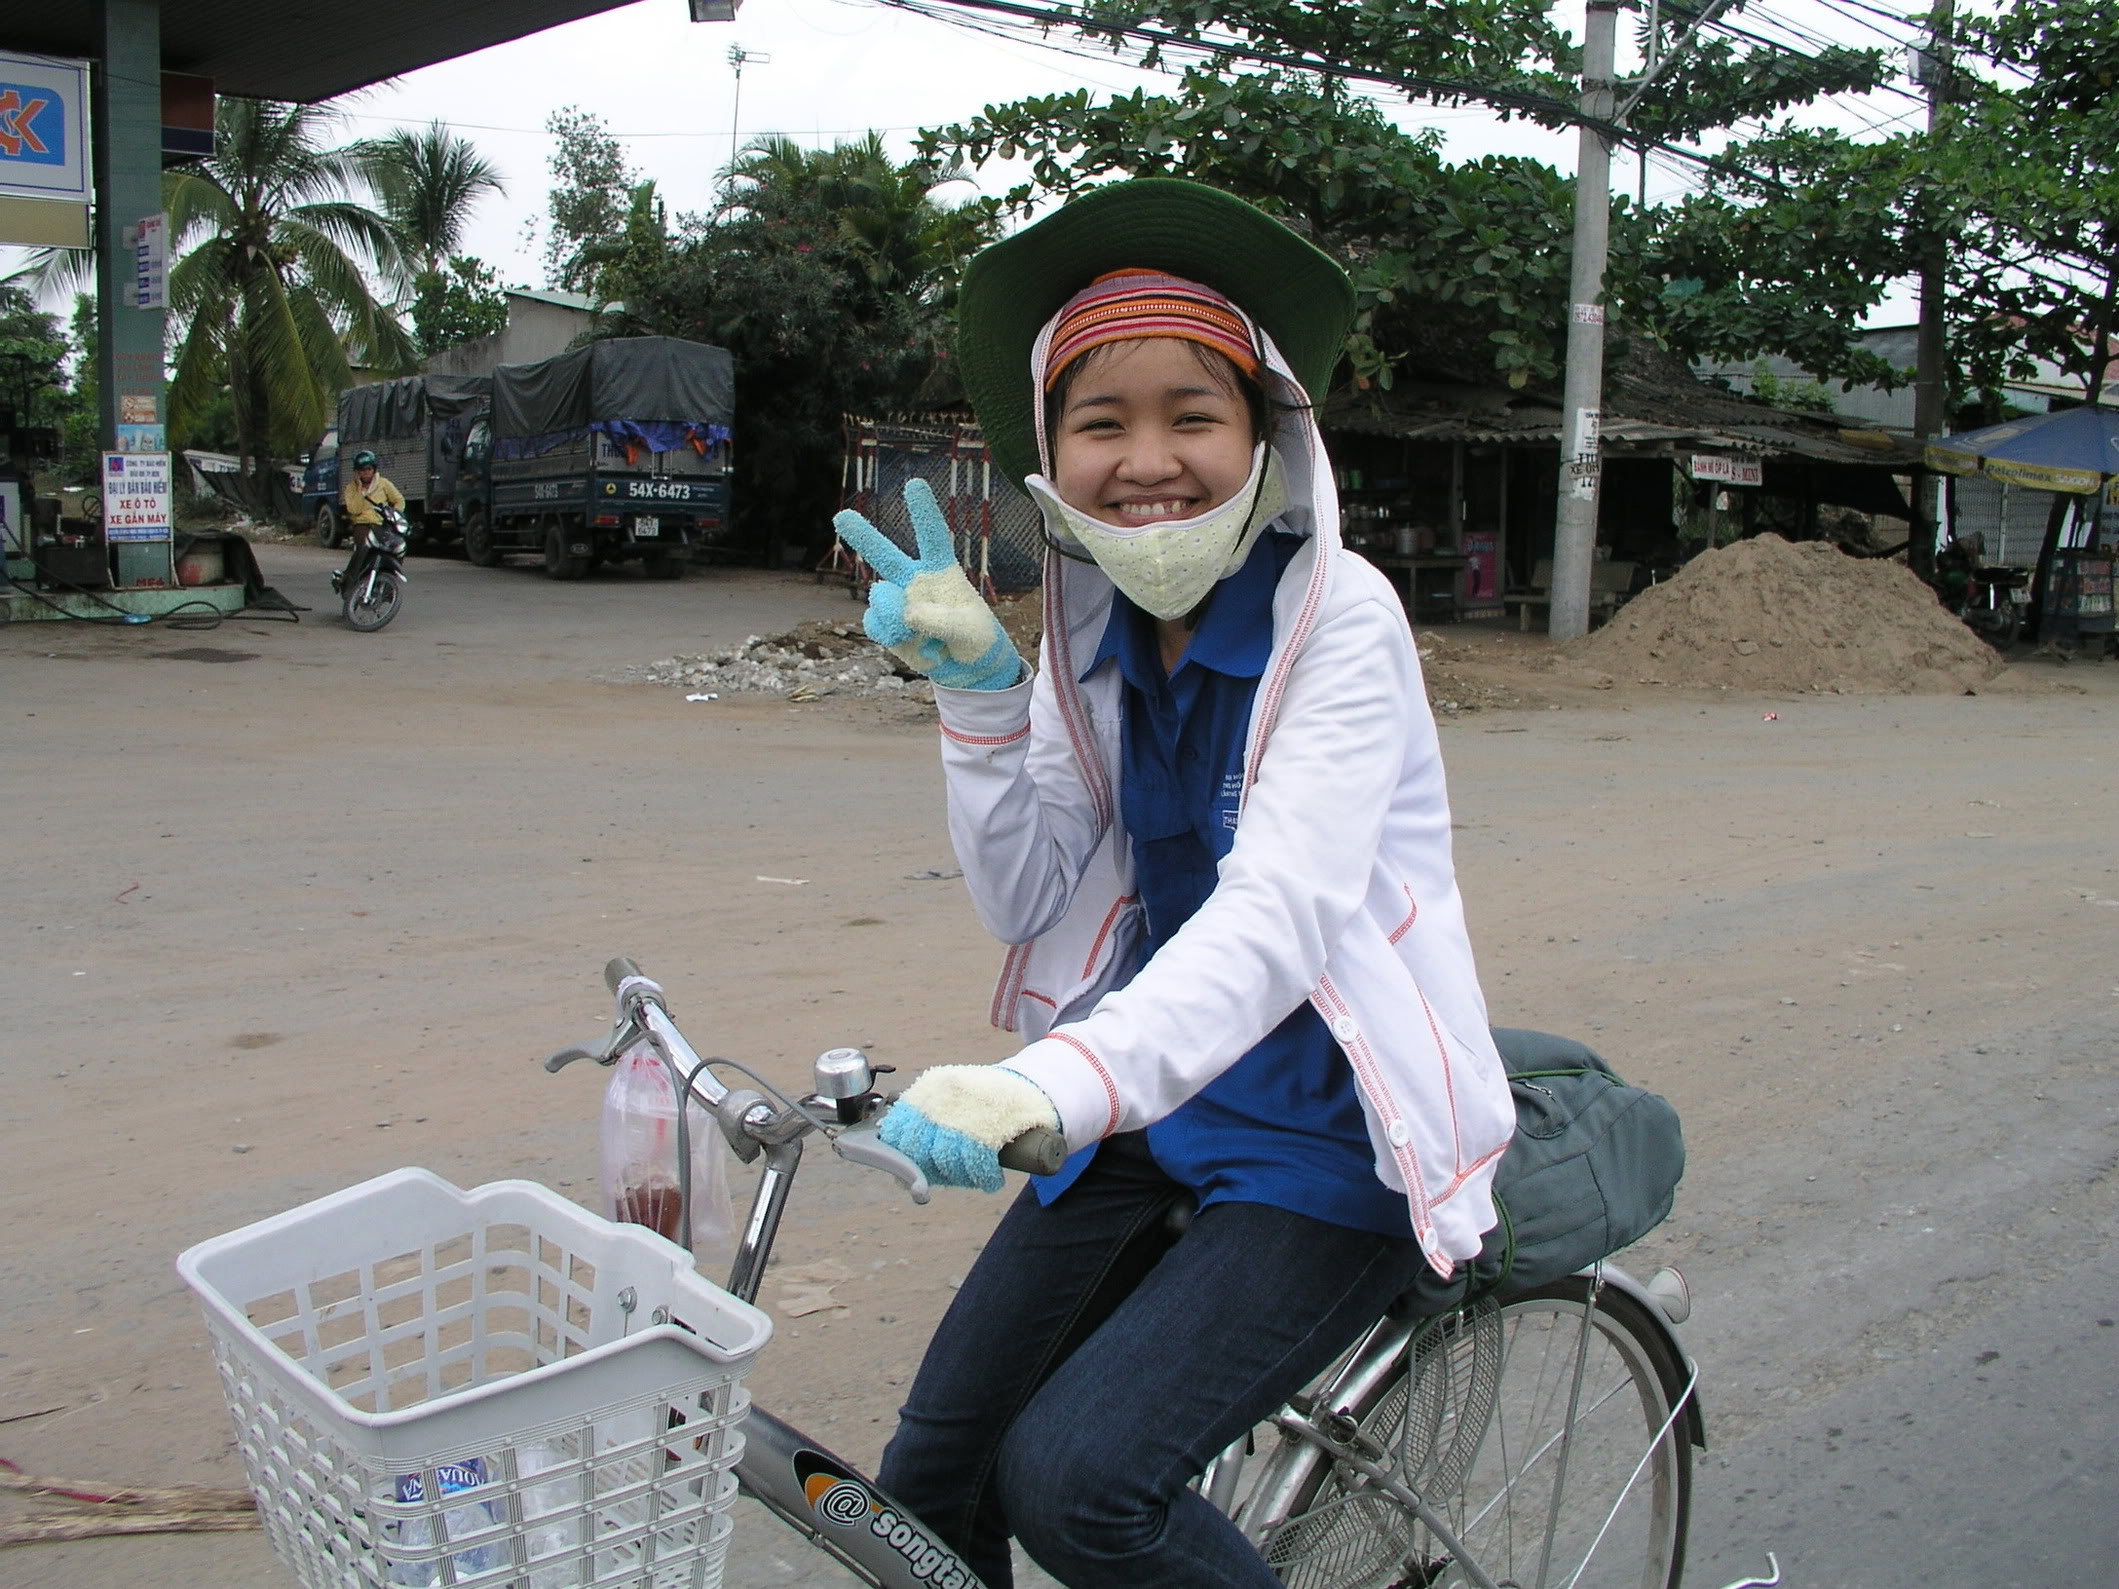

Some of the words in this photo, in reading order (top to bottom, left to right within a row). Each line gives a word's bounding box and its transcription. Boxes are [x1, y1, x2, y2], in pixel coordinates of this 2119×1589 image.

[120, 500, 132, 509] XE
[135, 497, 141, 509] Ô
[144, 497, 156, 509] TÔ
[111, 515, 122, 524] XE
[147, 511, 167, 524] MÁY
